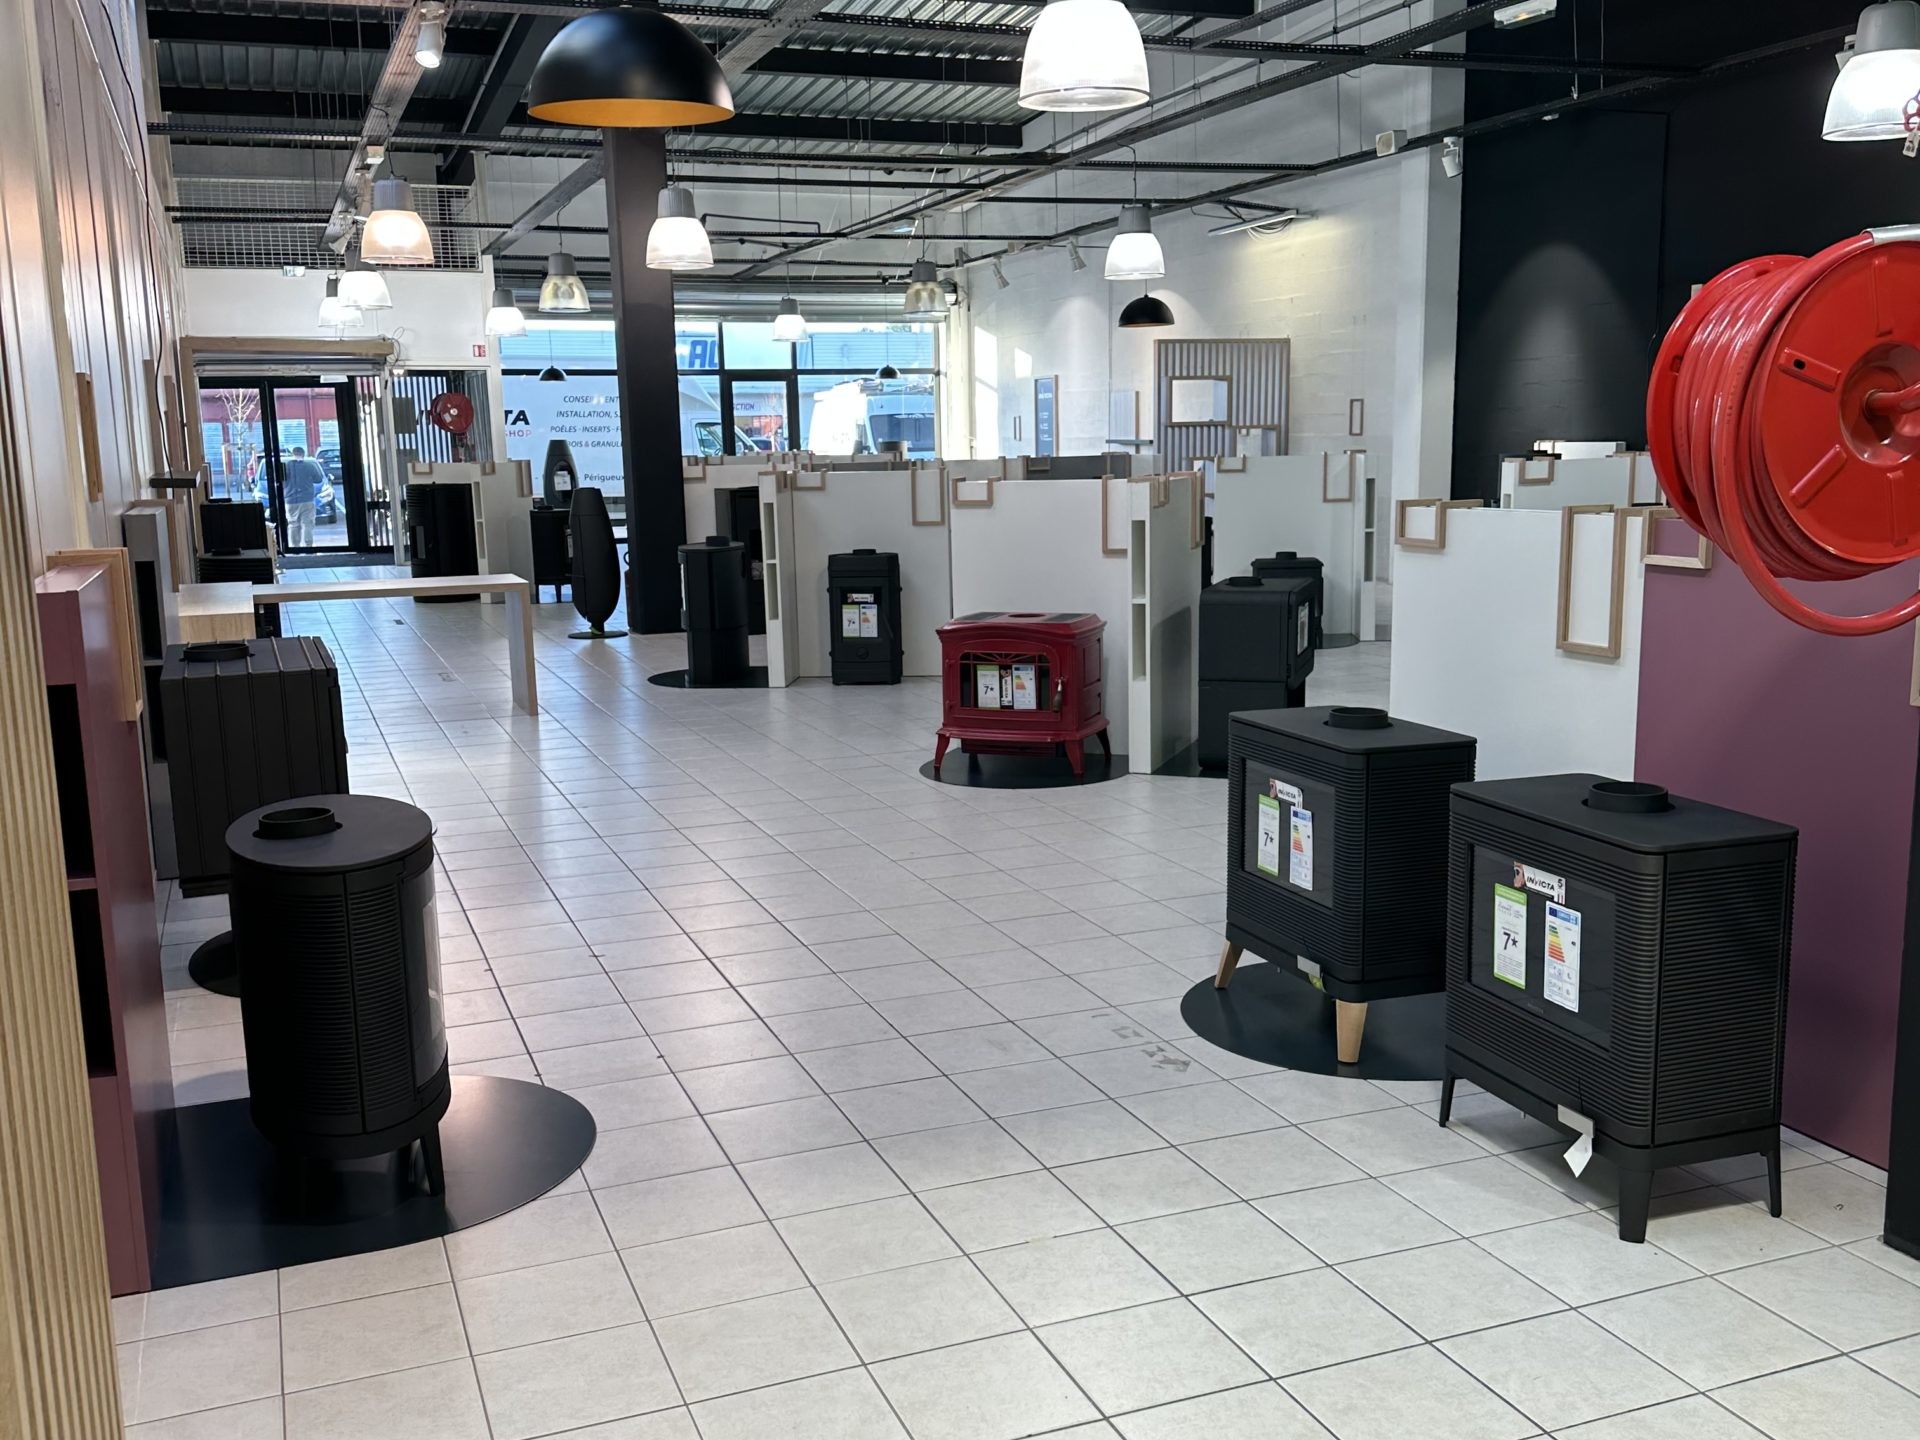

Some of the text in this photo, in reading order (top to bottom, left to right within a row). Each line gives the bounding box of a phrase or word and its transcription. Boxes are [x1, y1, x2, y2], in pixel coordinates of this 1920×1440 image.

[605, 396, 620, 404] ENT
[504, 410, 530, 425] TA
[556, 411, 612, 419] INSTALLATION,
[550, 425, 577, 433] POÊLES
[582, 425, 611, 433] INSERTS
[590, 440, 622, 448] GRANUL
[1526, 876, 1555, 891] INVICTA
